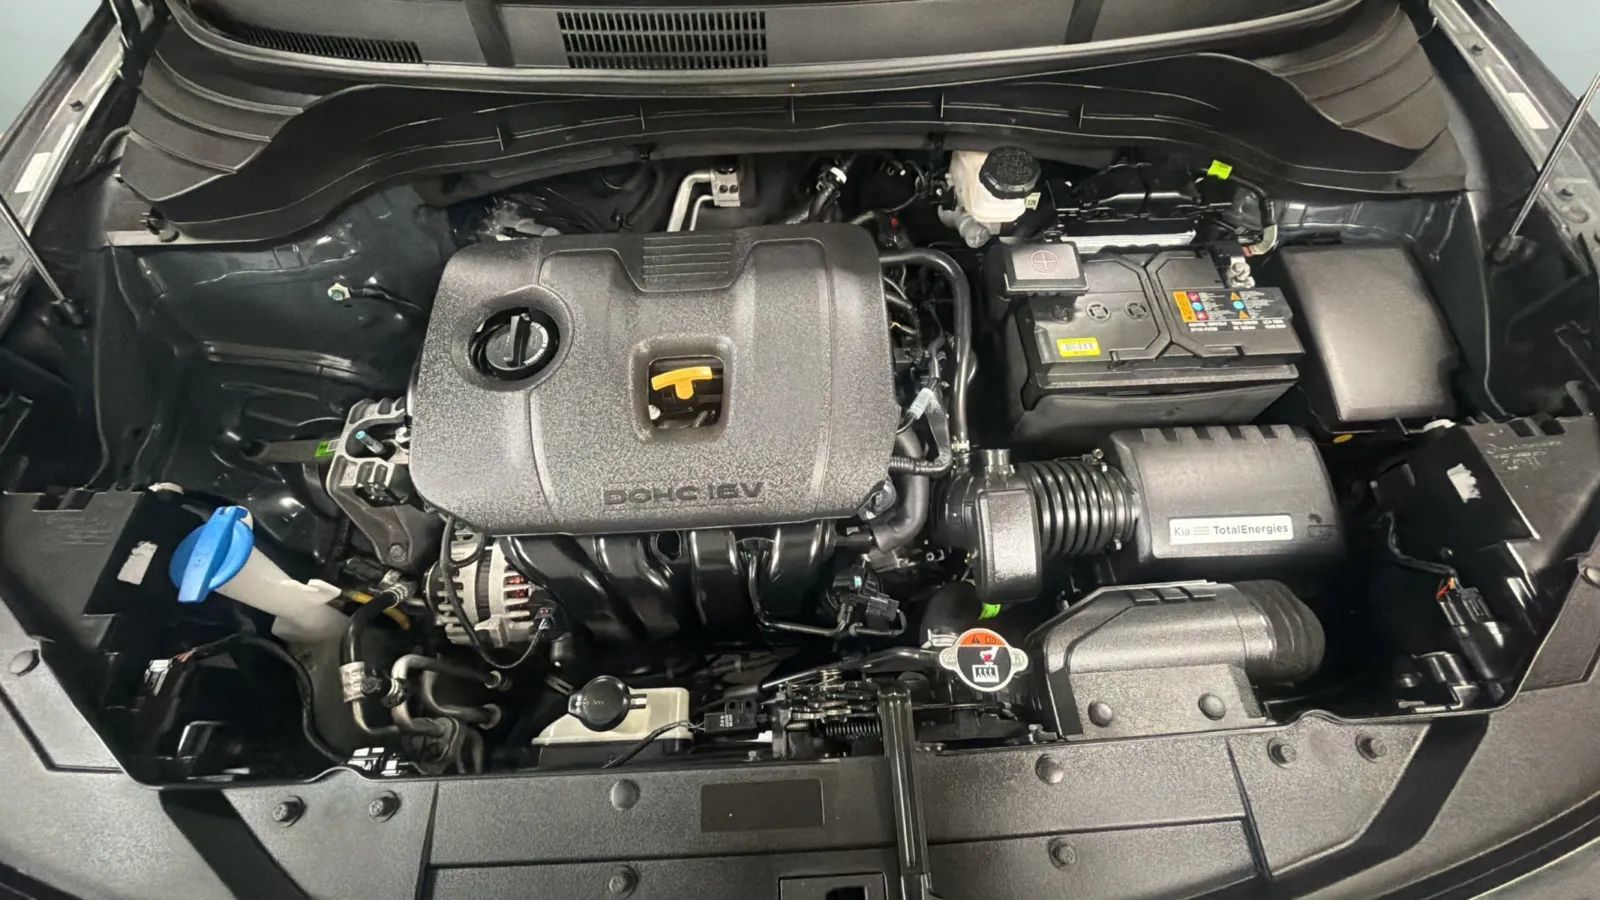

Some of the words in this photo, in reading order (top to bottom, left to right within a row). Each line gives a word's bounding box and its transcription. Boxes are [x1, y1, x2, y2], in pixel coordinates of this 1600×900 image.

[604, 486, 700, 505] DOHC
[708, 482, 764, 500] 16V
[1174, 527, 1191, 537] Kia
[1213, 523, 1289, 536] TotalEnergies
